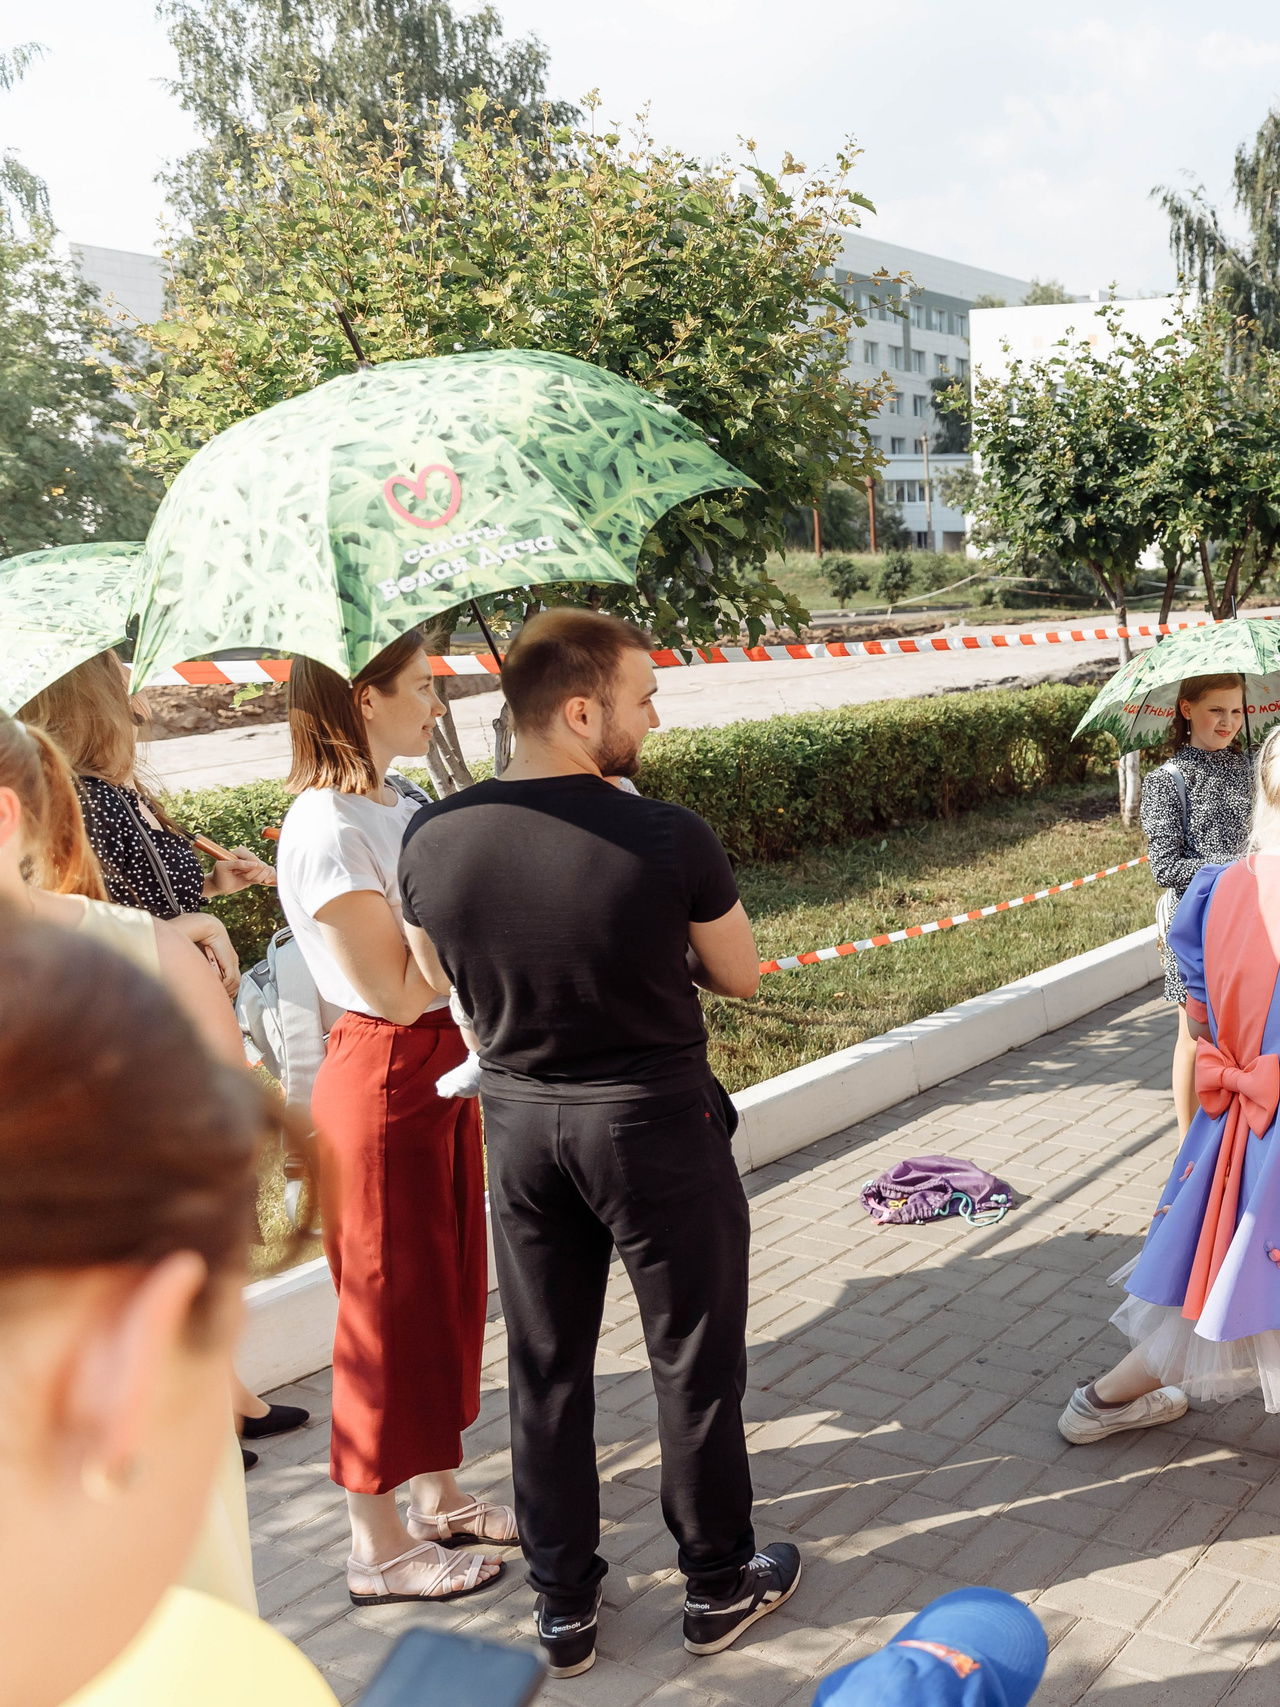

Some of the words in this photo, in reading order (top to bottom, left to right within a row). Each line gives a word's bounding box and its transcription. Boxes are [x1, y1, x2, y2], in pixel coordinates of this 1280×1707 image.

[404, 523, 508, 564] салаты
[377, 557, 471, 601] Белая
[478, 535, 558, 569] Дача
[686, 1601, 710, 1610] Reebok
[552, 1622, 581, 1634] Reebok
